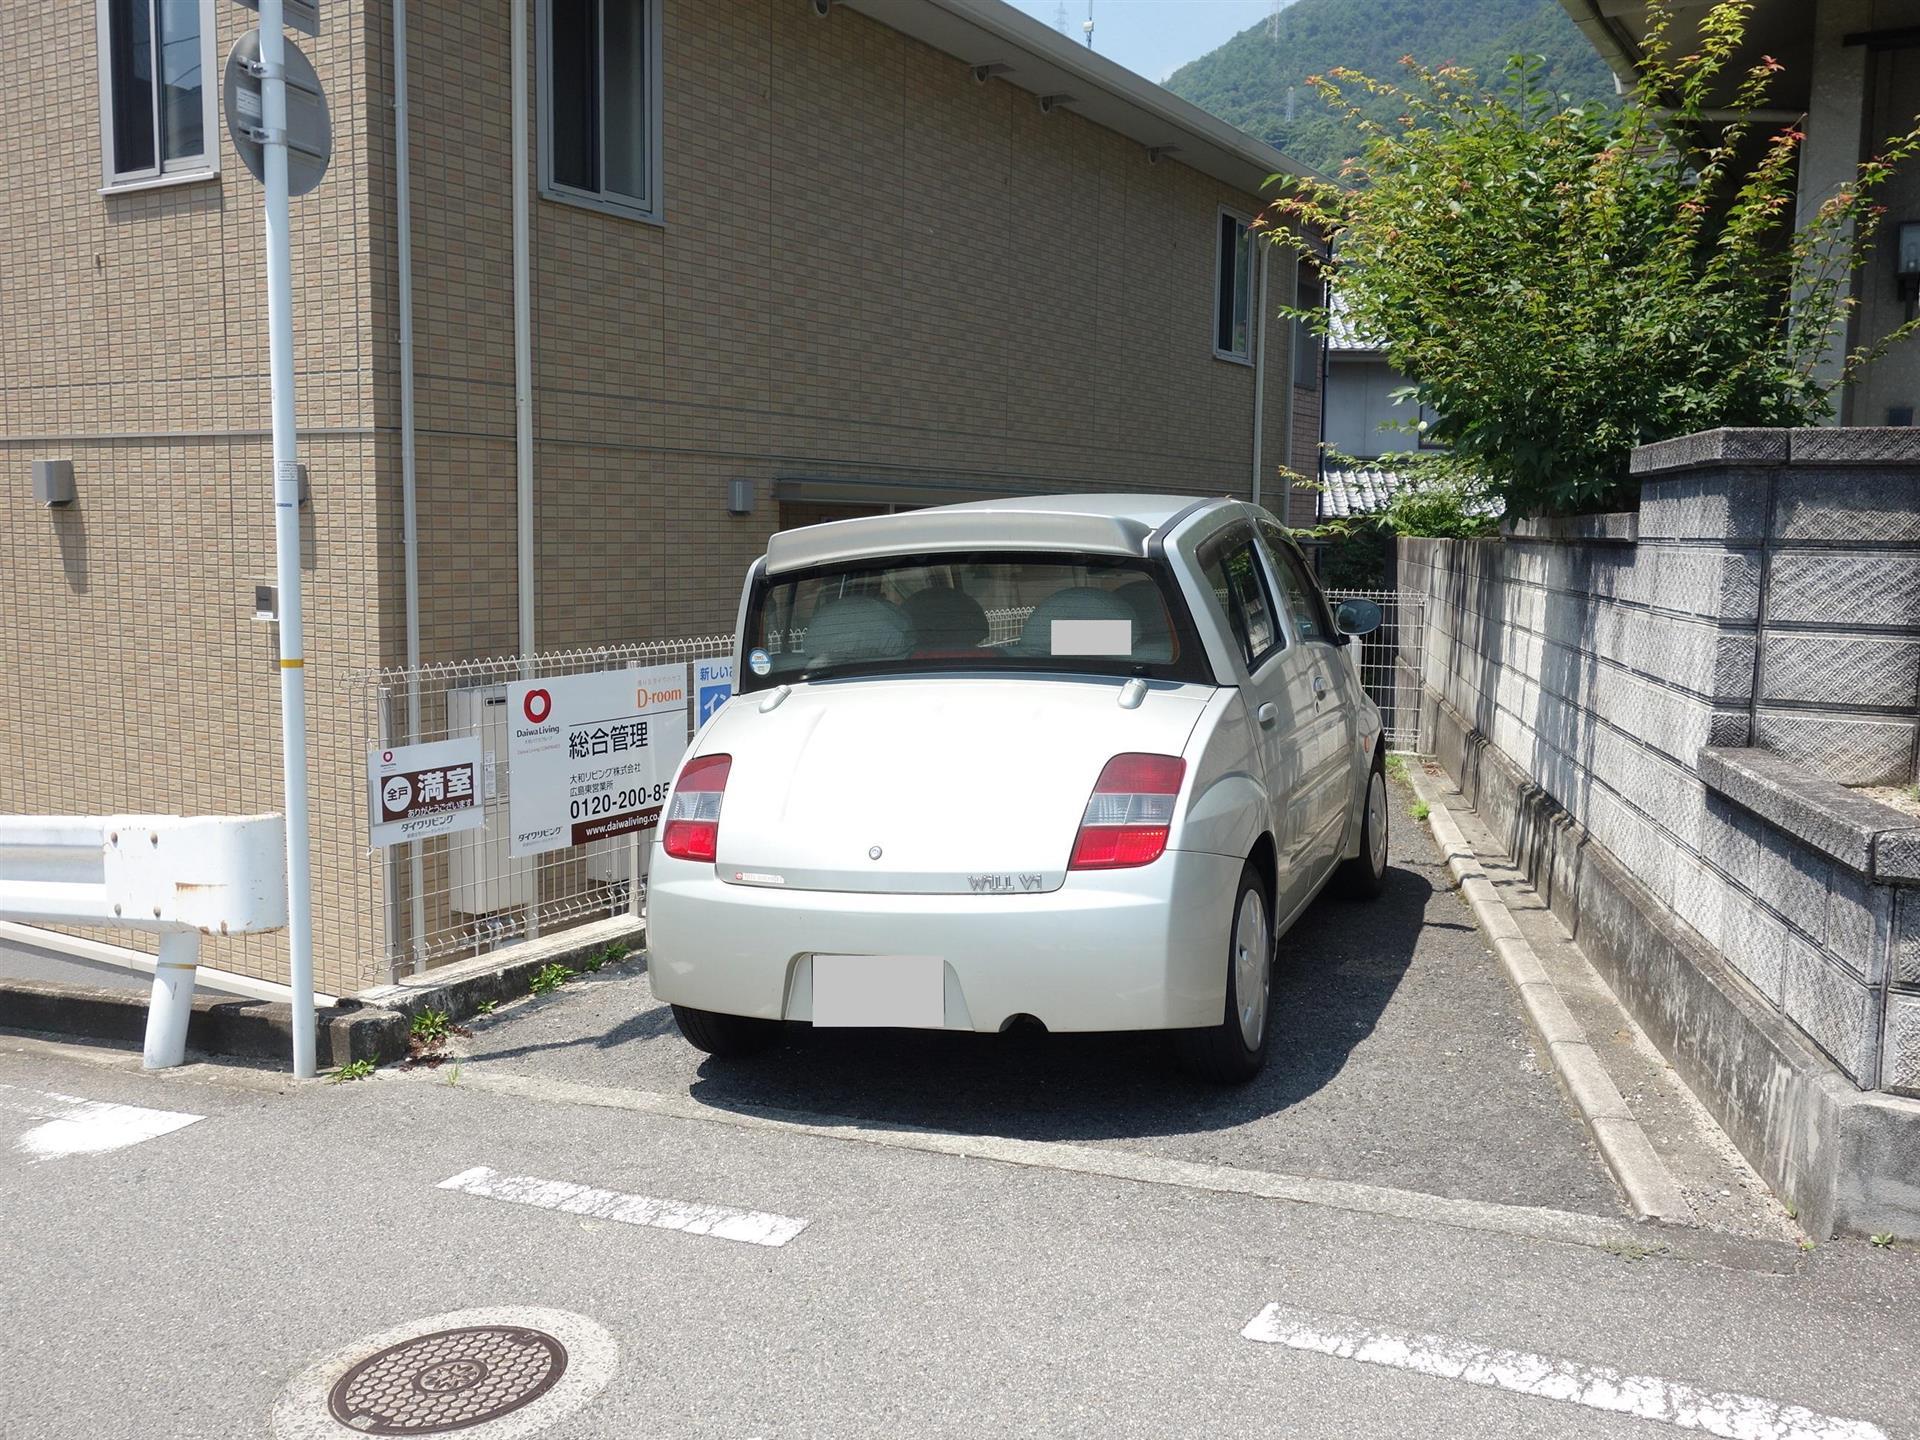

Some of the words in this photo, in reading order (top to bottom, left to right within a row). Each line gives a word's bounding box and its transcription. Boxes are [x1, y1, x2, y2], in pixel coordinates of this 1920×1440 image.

[637, 687, 682, 708] D-room
[516, 728, 538, 738] Daiwa
[539, 725, 560, 734] Living
[569, 721, 648, 760] 総合管理
[570, 762, 641, 784] 大和リビング株式会社
[387, 786, 408, 802] 全戸
[417, 767, 473, 803] 満室
[570, 782, 614, 797] 広島東営業所
[407, 799, 473, 818] ありがとうございます
[401, 815, 454, 832] ダイワリビング
[518, 826, 562, 841] ダイワリビング
